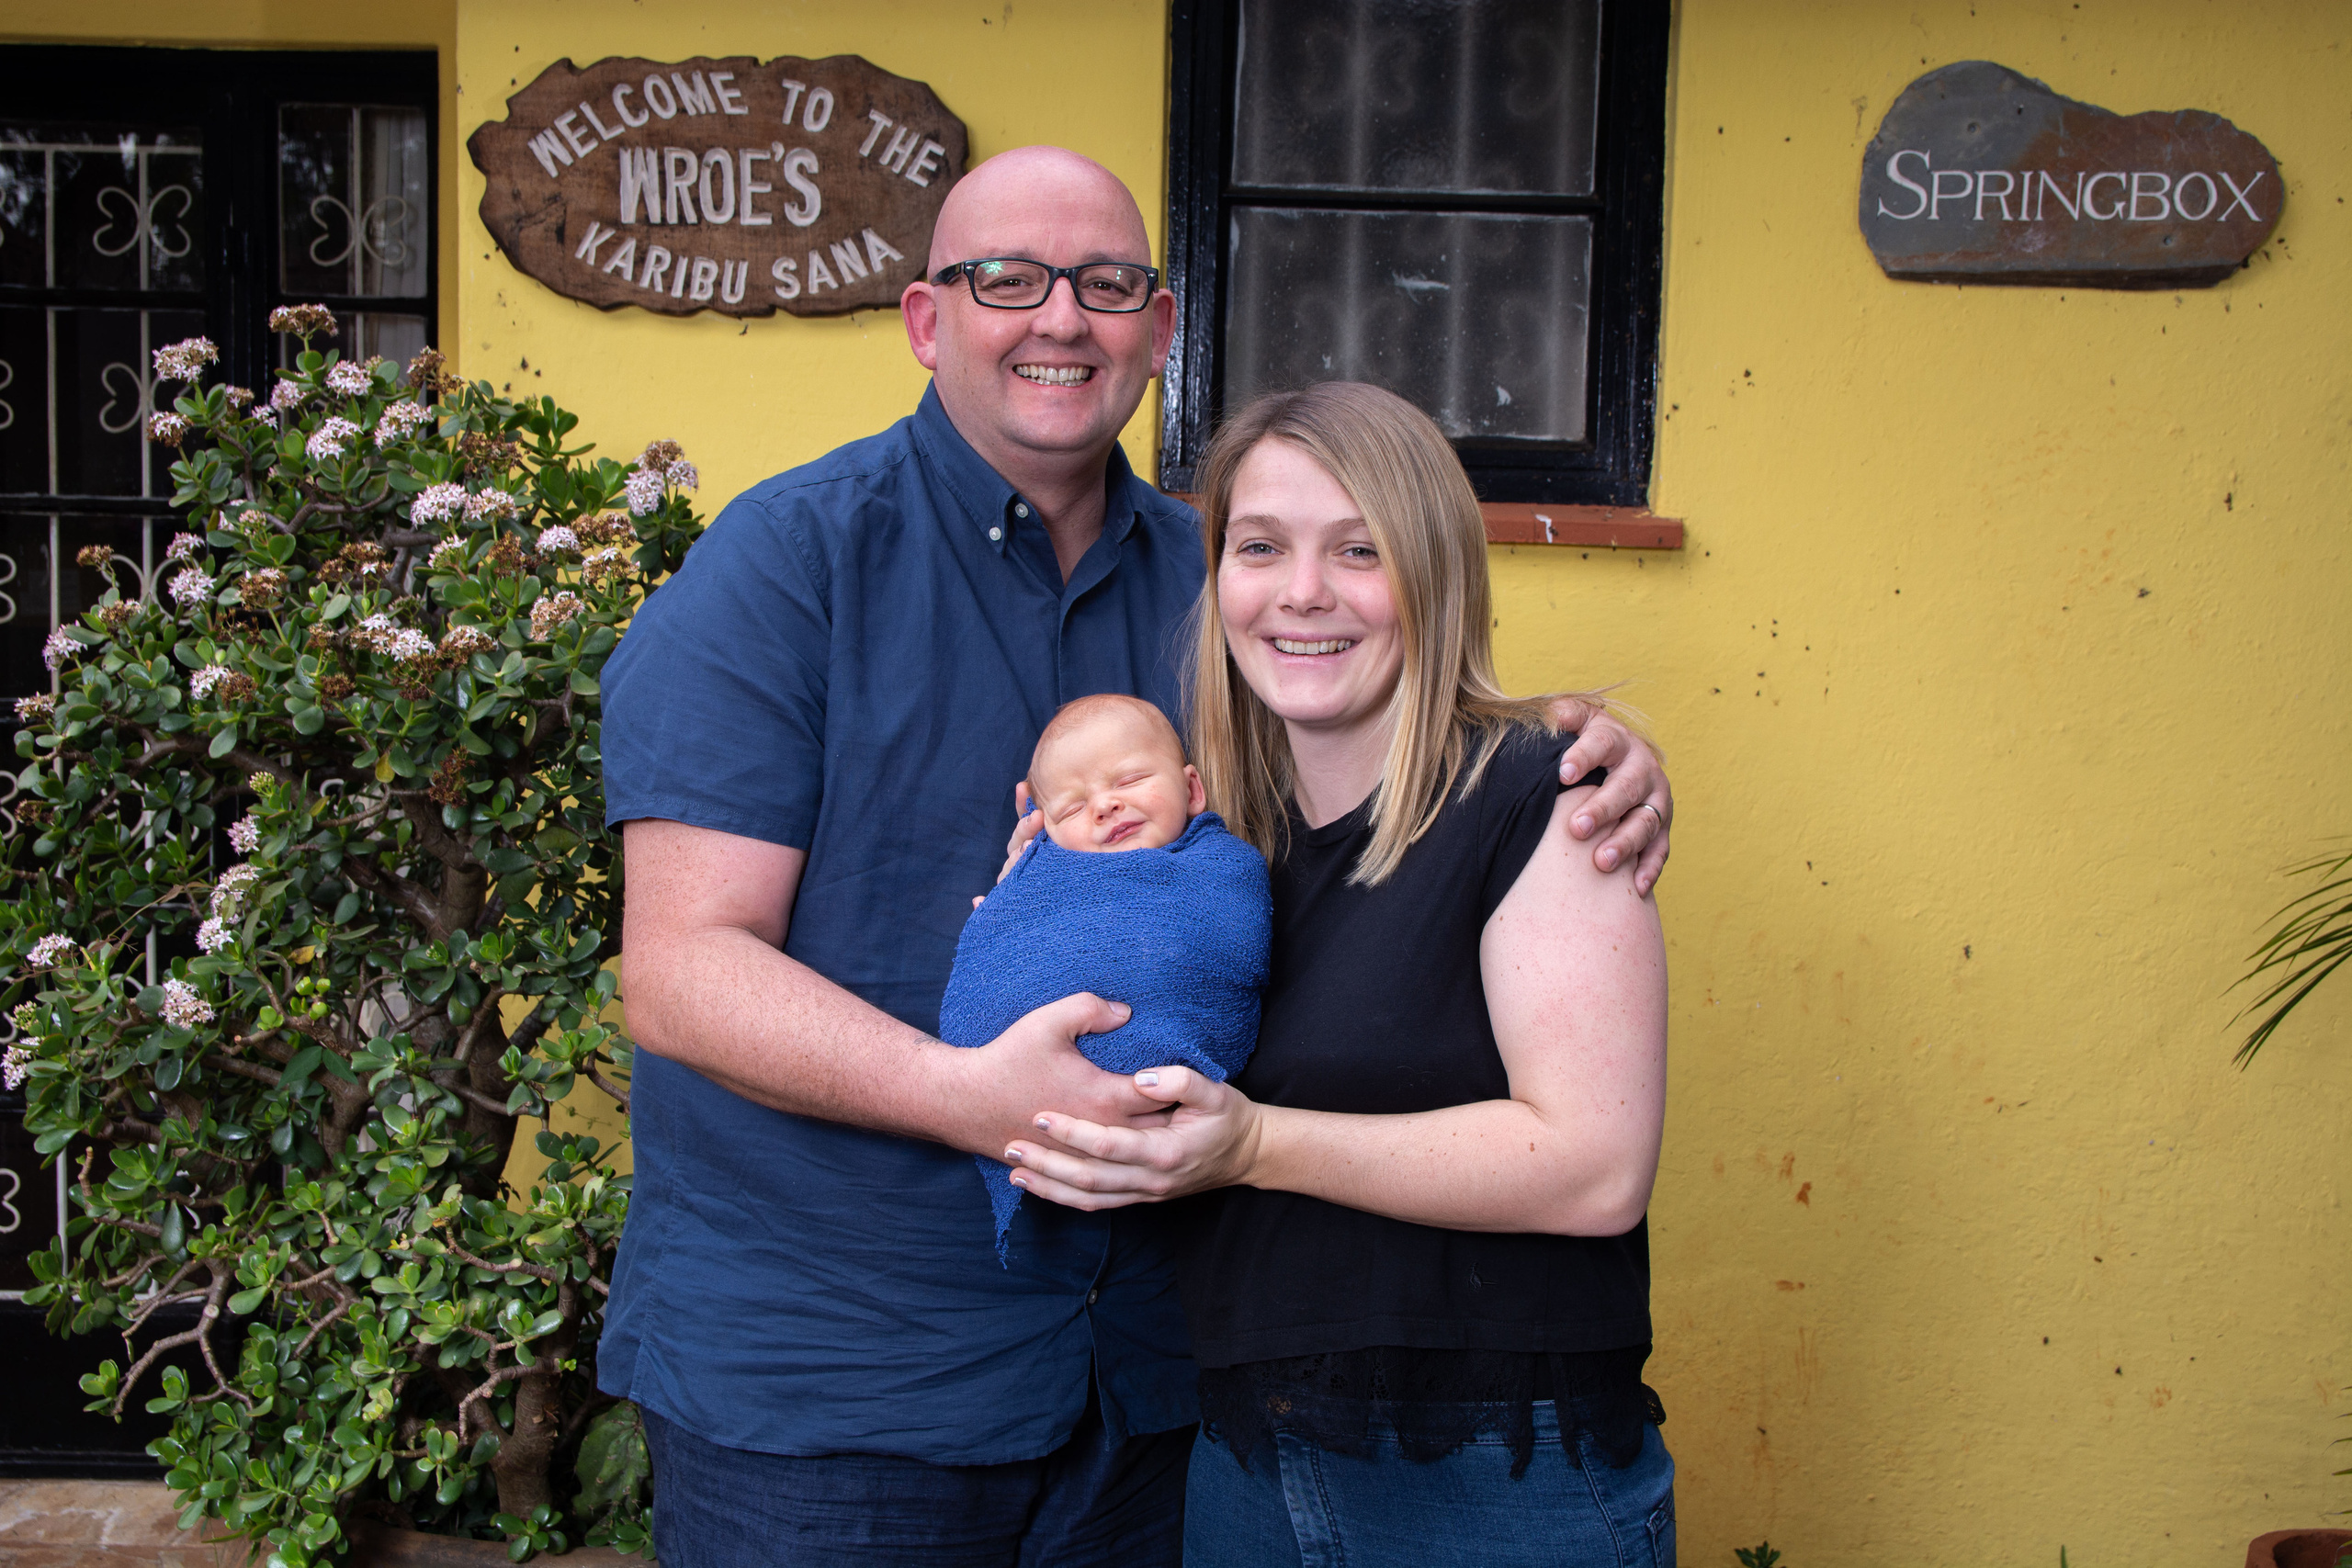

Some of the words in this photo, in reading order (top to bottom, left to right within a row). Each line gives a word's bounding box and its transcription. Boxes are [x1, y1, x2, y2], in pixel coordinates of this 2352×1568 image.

[528, 71, 749, 177] WELCOME
[781, 79, 834, 132] TO
[859, 109, 945, 187] THE
[619, 141, 821, 226] WROE'S
[574, 221, 749, 304] KARIBU
[771, 229, 904, 299] SANA
